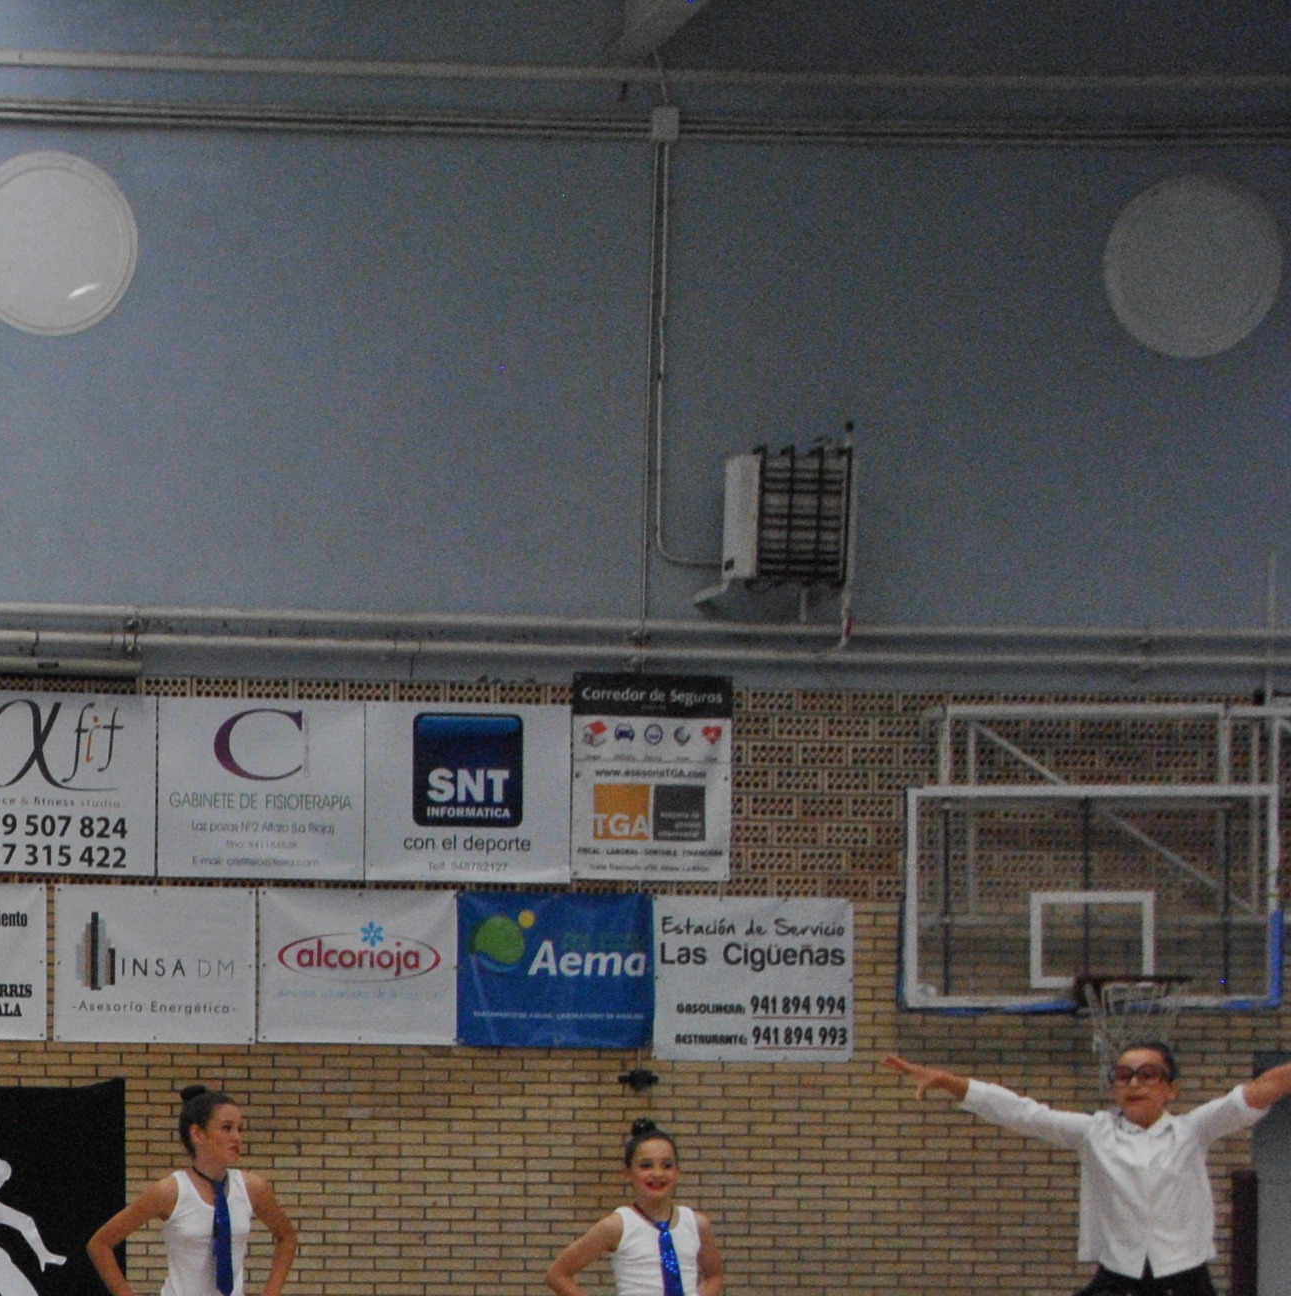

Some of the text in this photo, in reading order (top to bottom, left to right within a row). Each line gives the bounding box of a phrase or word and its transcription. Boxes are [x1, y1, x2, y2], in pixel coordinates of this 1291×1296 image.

[582, 687, 722, 706] Corredor de Seguros
[214, 708, 302, 781] C
[427, 768, 509, 803] SNT
[34, 796, 74, 806] fitness
[169, 792, 352, 810] GABINETE DE FISIOTERAPIA
[25, 815, 72, 837] 507
[80, 817, 127, 839] 824
[593, 814, 650, 836] TGA
[403, 835, 531, 854] con el deporte
[25, 844, 71, 866] 315
[80, 847, 127, 868] 422
[662, 916, 845, 936] Estación de Servicio
[296, 938, 420, 977] alcorioja
[528, 940, 646, 977] Aema
[660, 942, 845, 972] Las Cigüeñas
[751, 995, 777, 1014] 941
[782, 996, 810, 1015] 894
[816, 996, 845, 1015] 994
[752, 1026, 779, 1045] 941
[784, 1027, 812, 1045] 894
[819, 1027, 847, 1045] 993
